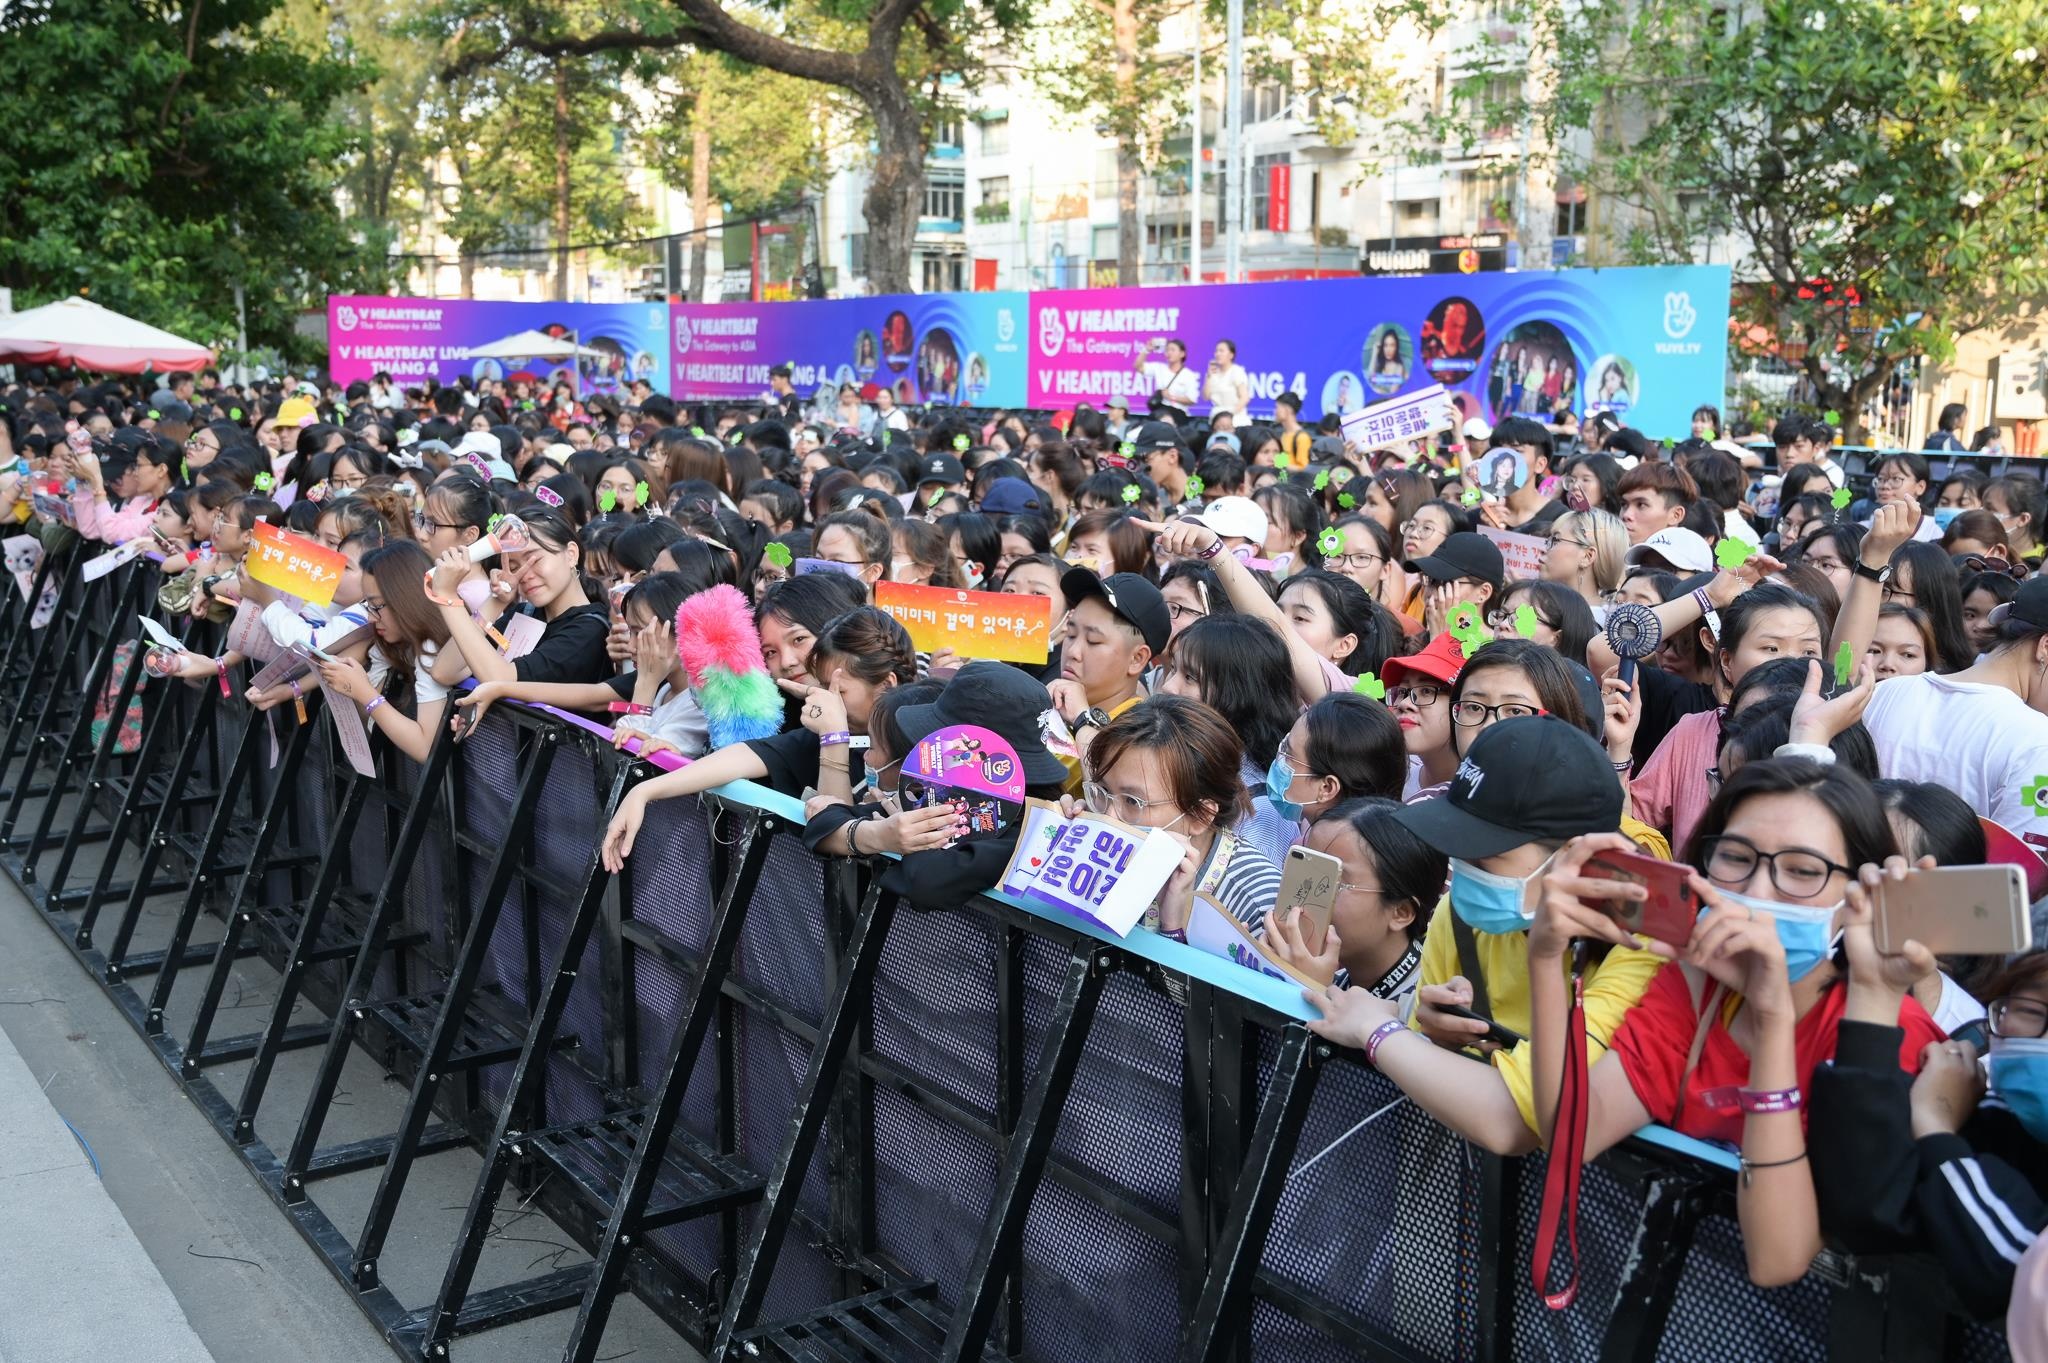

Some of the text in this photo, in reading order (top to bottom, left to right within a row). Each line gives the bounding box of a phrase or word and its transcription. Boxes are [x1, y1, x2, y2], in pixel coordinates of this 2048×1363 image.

[359, 308, 443, 321] V HEARTBEAT
[1065, 308, 1179, 332] V HEARTBEAT
[691, 317, 758, 335] V HEARTBEAT
[338, 345, 351, 360] V
[354, 345, 436, 360] HEARTBEAT
[1066, 338, 1084, 353] The
[1086, 338, 1132, 357] Gateway
[427, 361, 439, 375] 4
[676, 363, 687, 381] V
[687, 364, 744, 384] HEARTBEAT
[746, 365, 769, 384] LIVE
[817, 365, 827, 384] 4
[1038, 370, 1054, 393] V
[1289, 371, 1308, 401] 4
[262, 544, 285, 563] 곁에
[943, 612, 975, 632] 곁에
[981, 616, 1028, 639] 있어용
